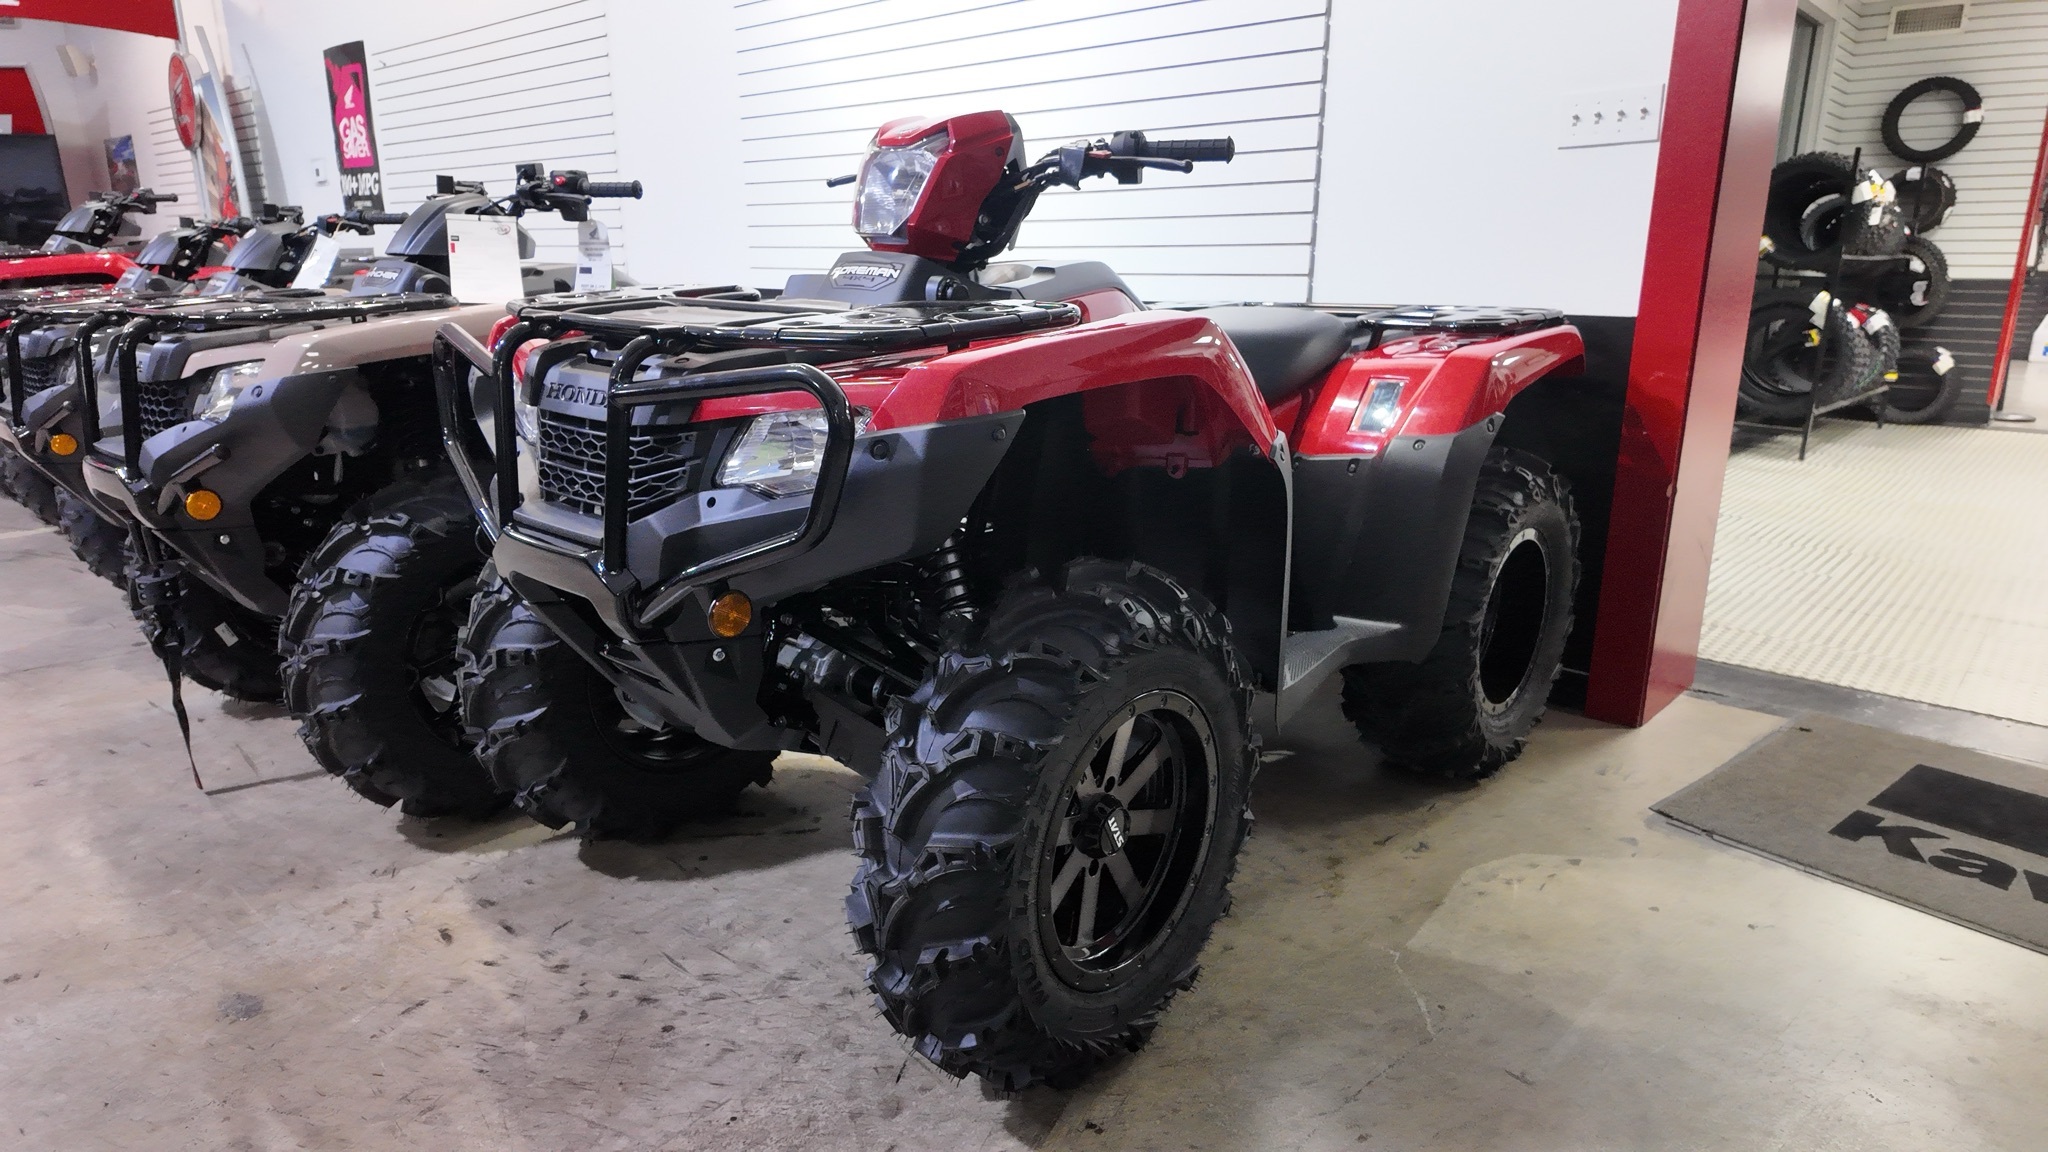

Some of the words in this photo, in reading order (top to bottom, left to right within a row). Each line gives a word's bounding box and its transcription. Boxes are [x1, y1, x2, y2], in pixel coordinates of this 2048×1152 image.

[339, 114, 366, 142] GAS
[343, 138, 371, 159] SAVER
[357, 172, 379, 196] MPG
[831, 265, 900, 279] FOREMAN
[546, 382, 607, 408] HOND
